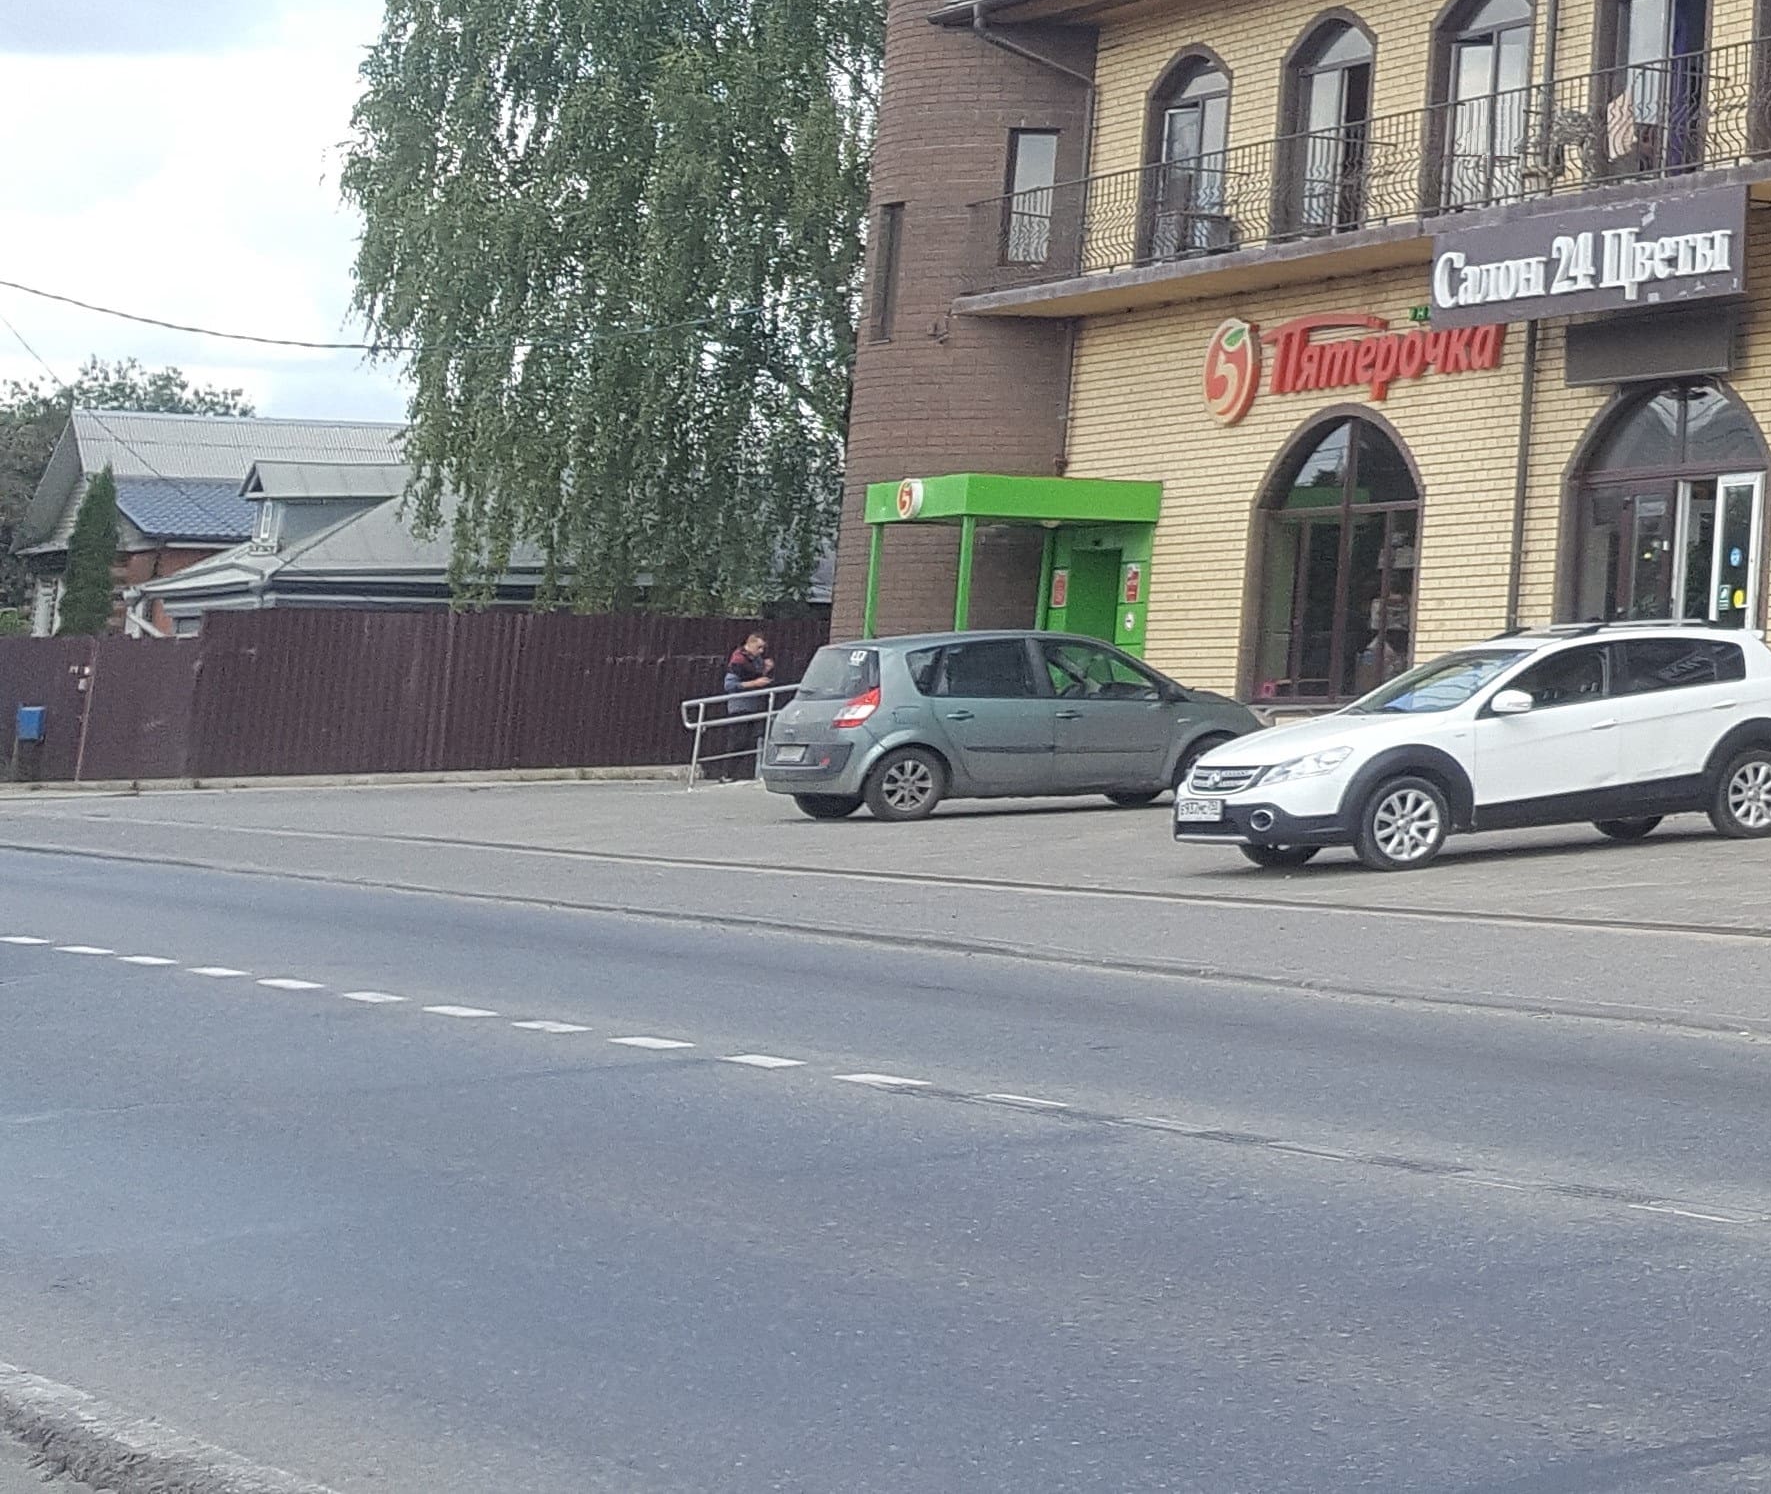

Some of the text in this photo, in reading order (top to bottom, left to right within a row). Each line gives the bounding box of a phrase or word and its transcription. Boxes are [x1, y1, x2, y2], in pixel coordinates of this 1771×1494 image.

[1433, 227, 1733, 308] Салон 24 Цветы
[1261, 313, 1507, 402] Пятерочка
